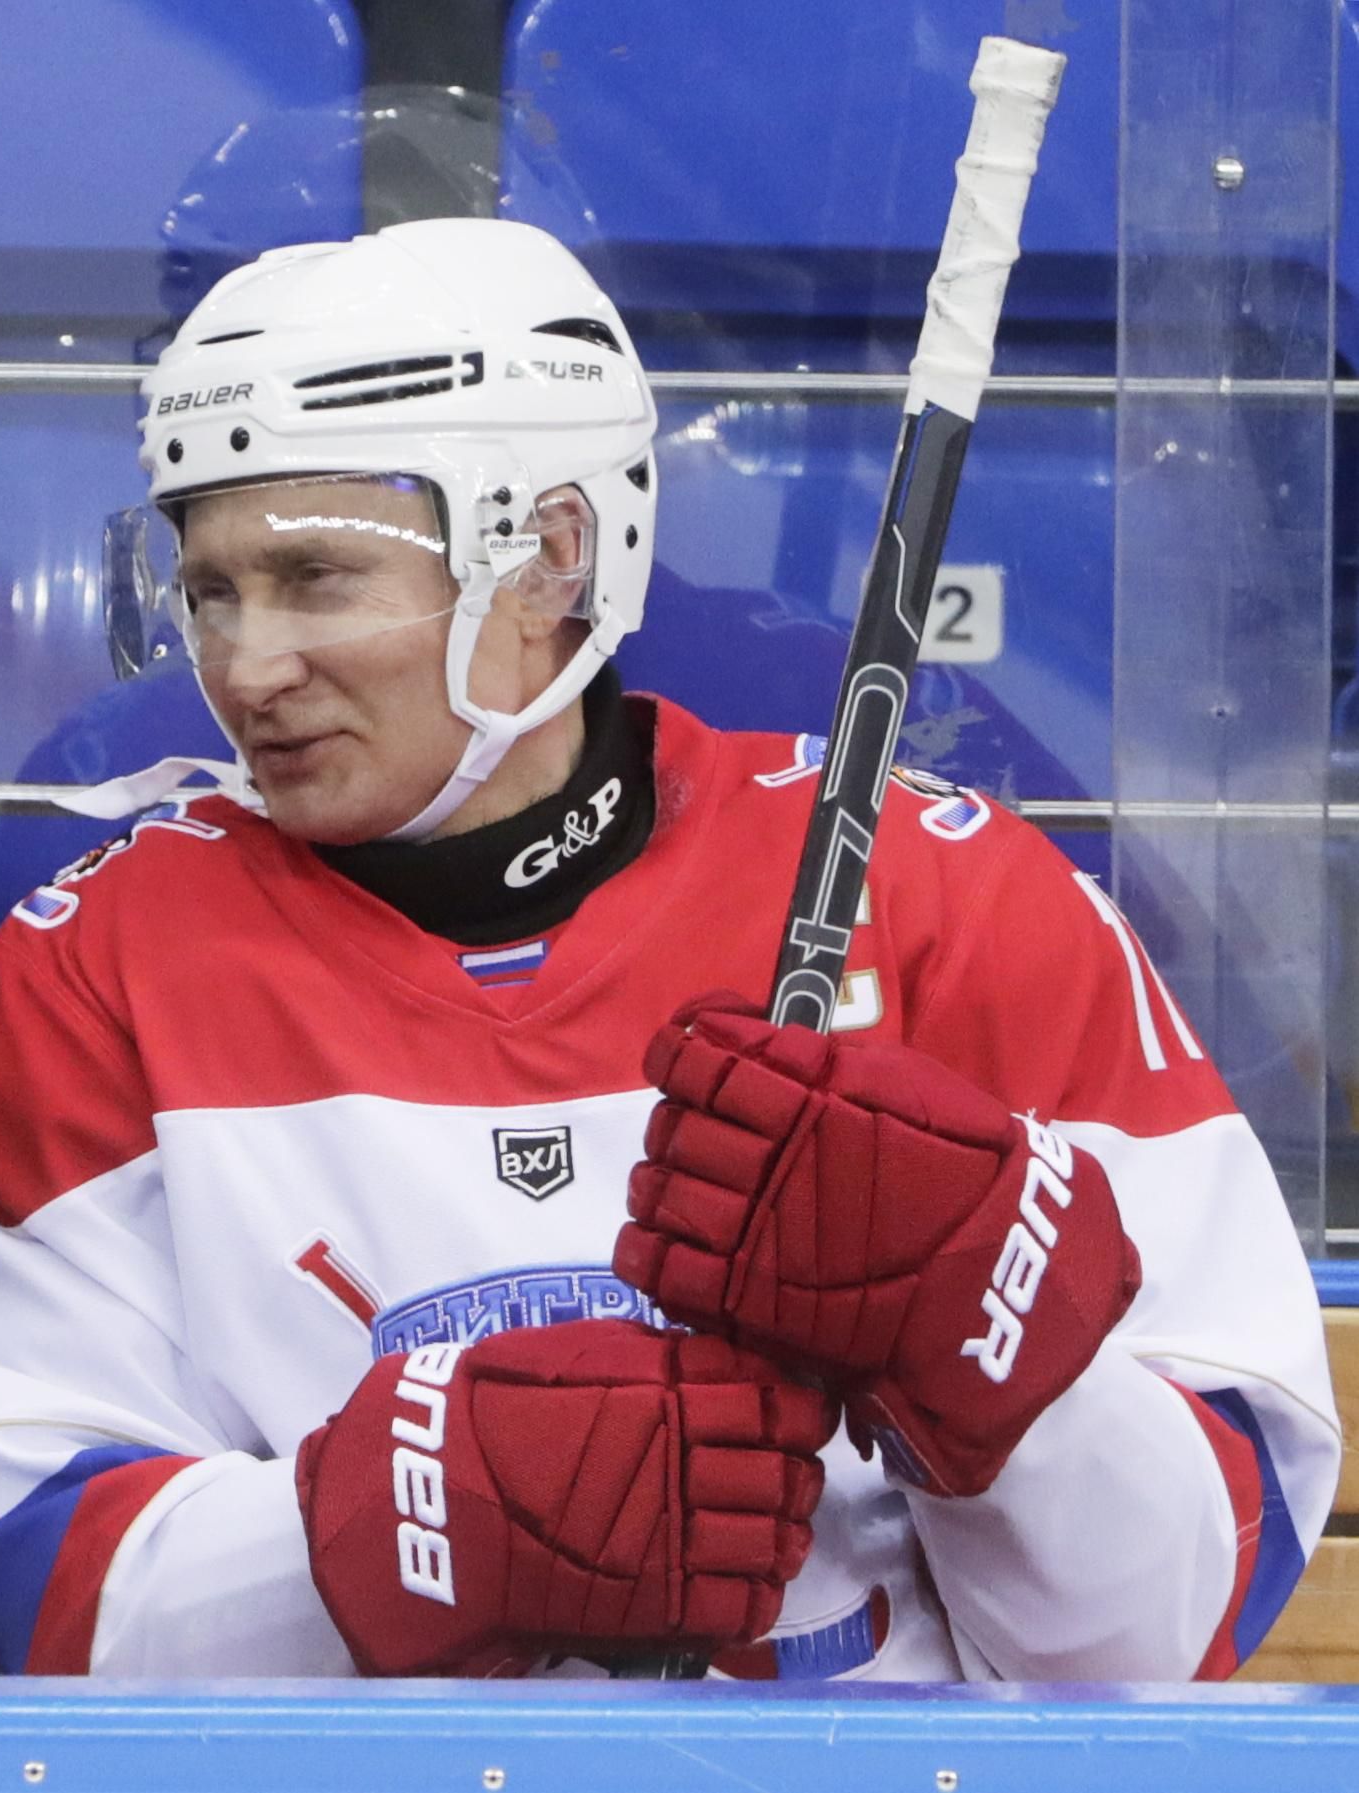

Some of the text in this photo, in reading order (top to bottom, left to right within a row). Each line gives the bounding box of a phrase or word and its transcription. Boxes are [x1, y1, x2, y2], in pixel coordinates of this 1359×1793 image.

[156, 383, 254, 415] BAUER
[489, 540, 538, 549] BAUER
[935, 585, 973, 643] 2
[504, 777, 623, 888] G&P
[501, 1141, 568, 1177] ВХЛ
[960, 1110, 1073, 1383] AUER
[380, 1270, 690, 1355] ТИГР
[391, 1341, 474, 1606] BAUE
